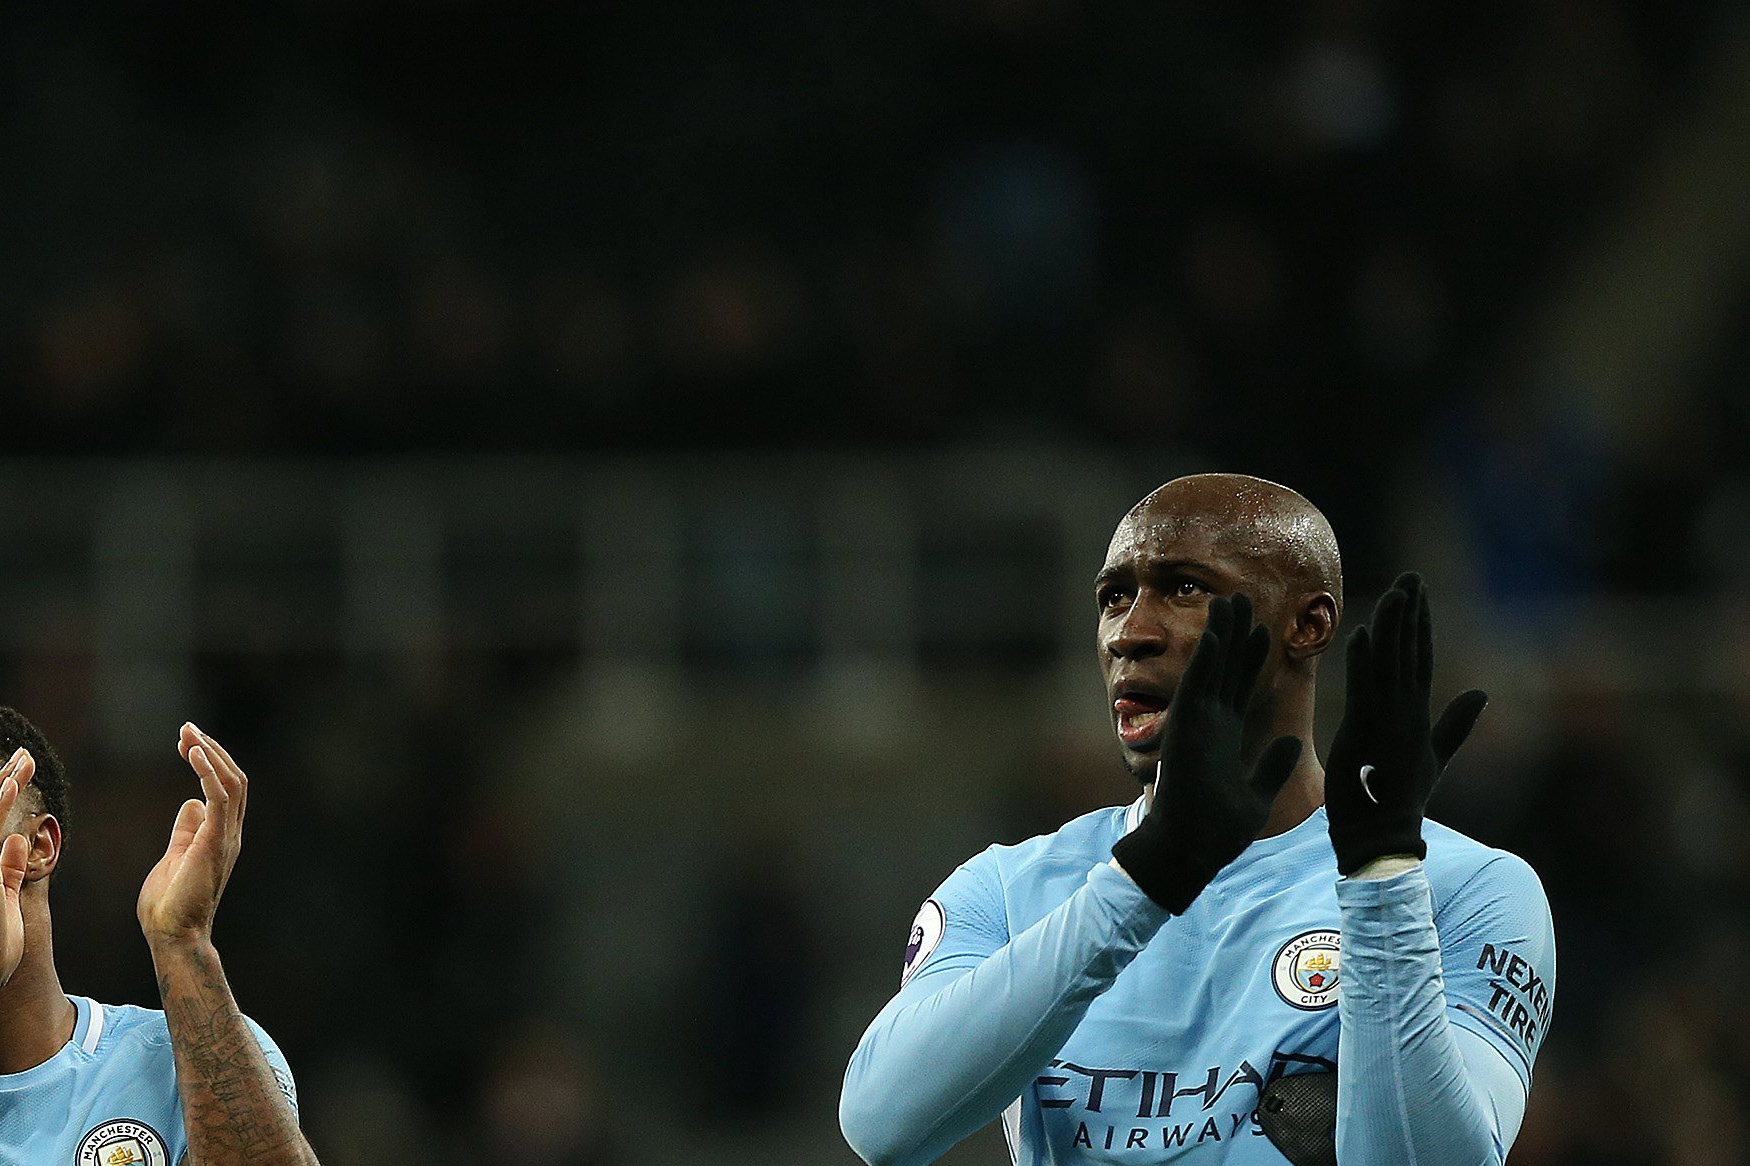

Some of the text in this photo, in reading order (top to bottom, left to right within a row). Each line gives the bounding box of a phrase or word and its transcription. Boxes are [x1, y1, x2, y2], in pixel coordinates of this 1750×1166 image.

[1284, 935, 1342, 959] MANCHES
[1300, 995, 1328, 1004] CITY
[1476, 943, 1550, 1032] NEXEN
[1488, 980, 1537, 1053] TIRE
[83, 1125, 154, 1160] MANCHESTER
[1072, 1109, 1266, 1150] AIRWAYS
